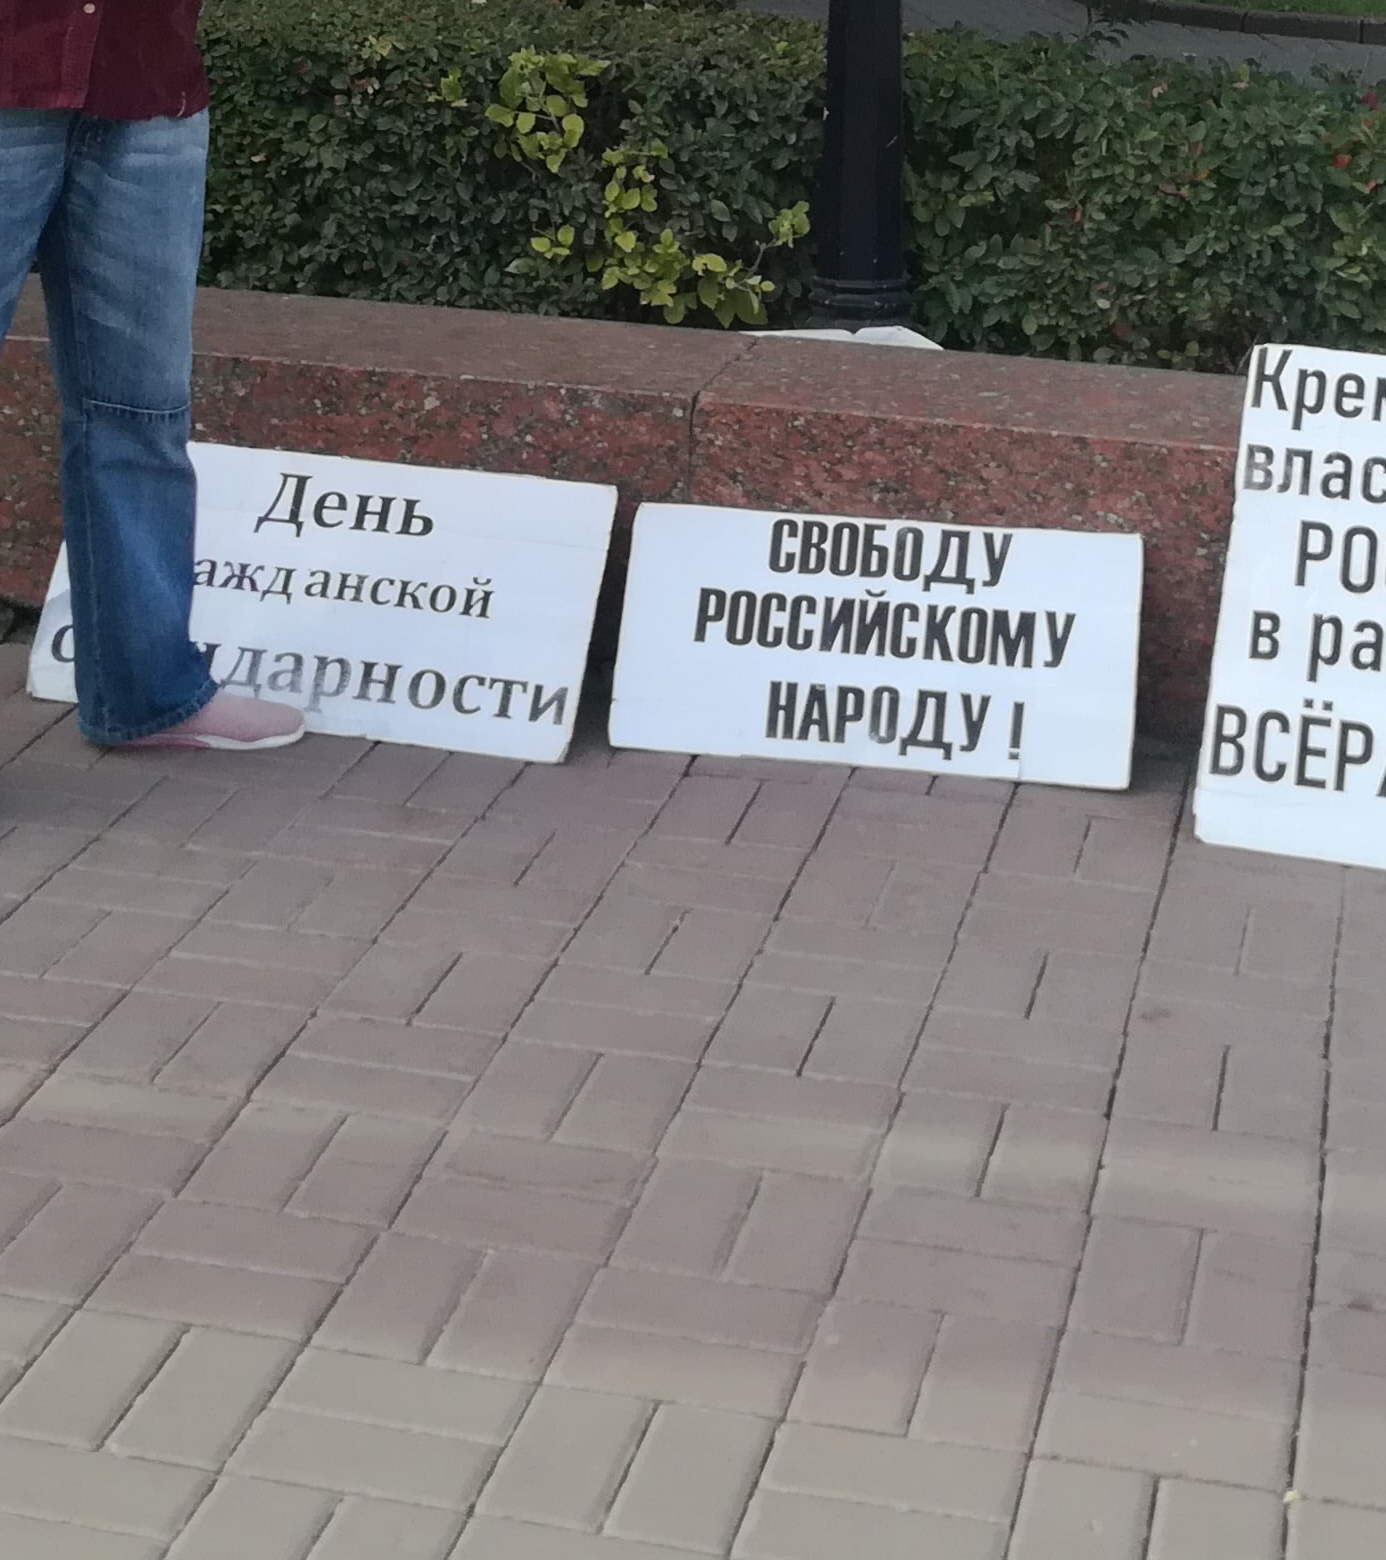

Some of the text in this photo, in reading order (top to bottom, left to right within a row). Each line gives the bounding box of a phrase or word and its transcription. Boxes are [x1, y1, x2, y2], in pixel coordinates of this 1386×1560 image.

[254, 471, 435, 538] День
[193, 557, 495, 619] ажданской
[768, 517, 1014, 595] СВОБОДУ
[693, 586, 1077, 669] РОССИЙСКОМУ
[1248, 609, 1282, 661] в
